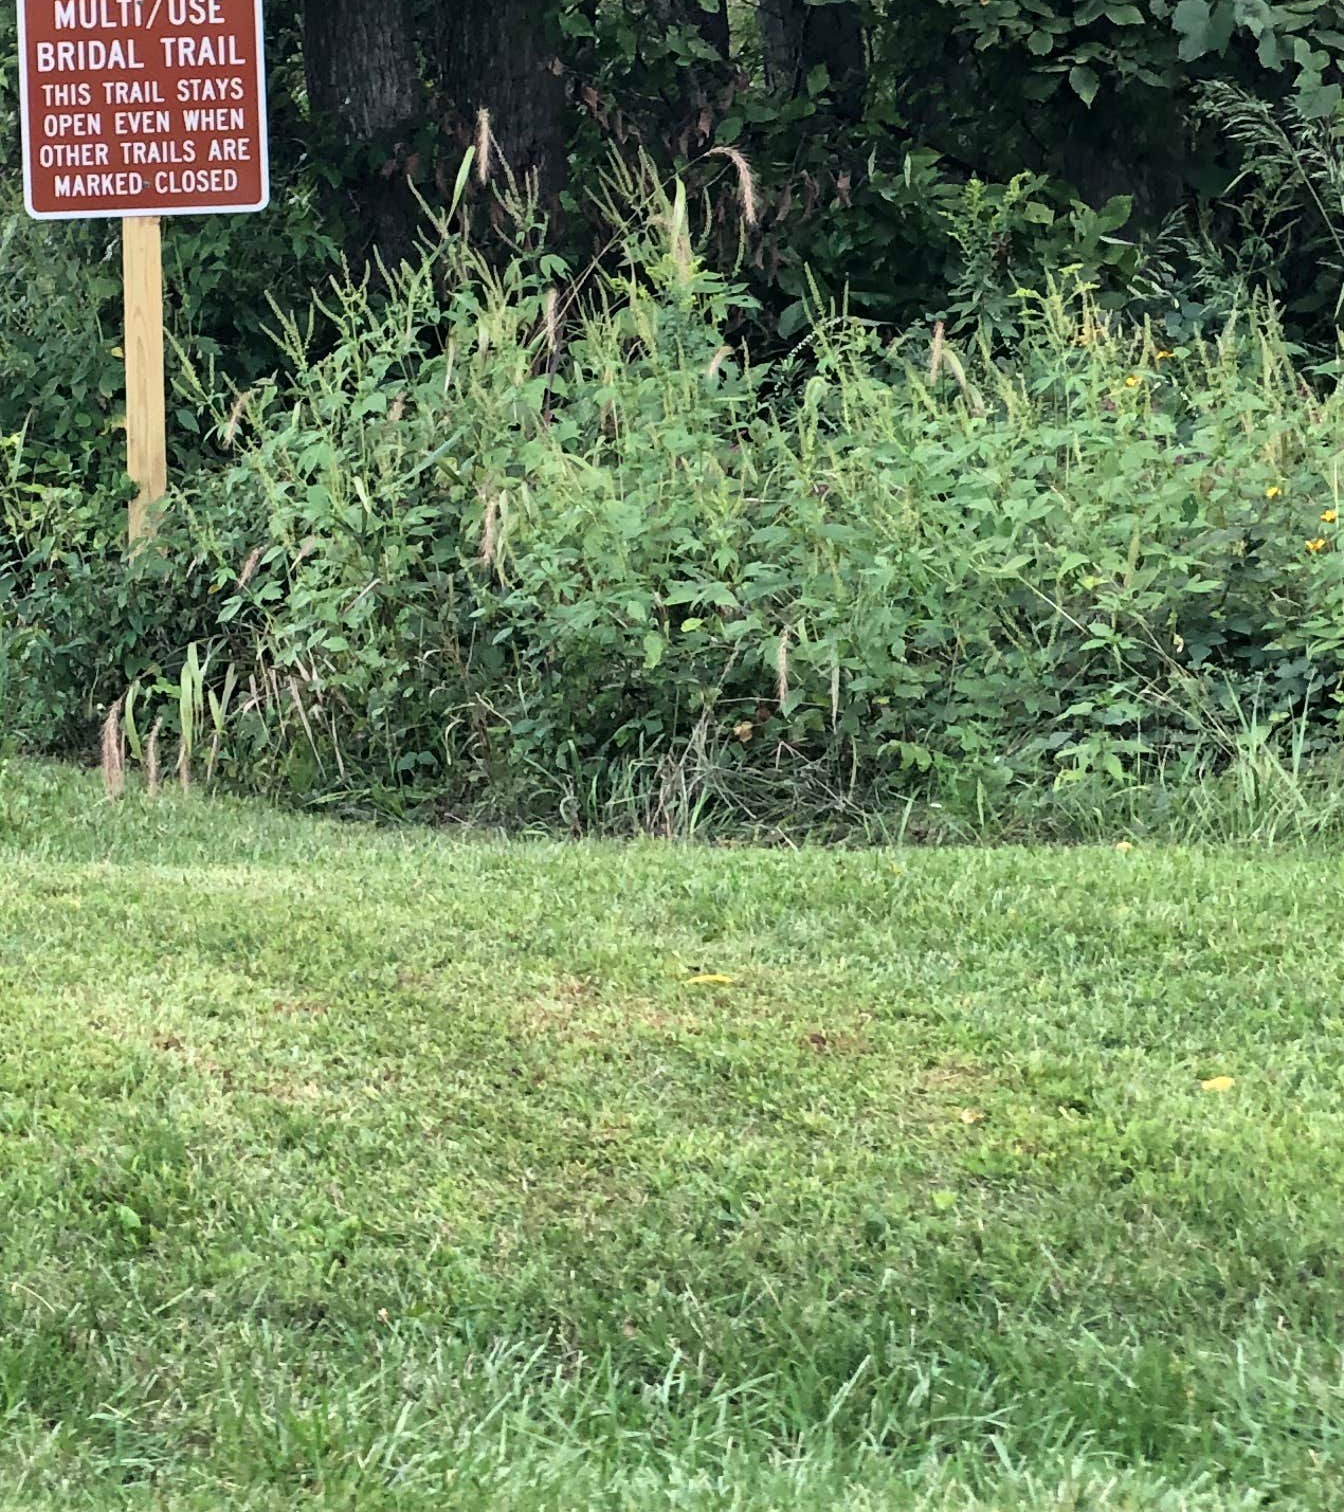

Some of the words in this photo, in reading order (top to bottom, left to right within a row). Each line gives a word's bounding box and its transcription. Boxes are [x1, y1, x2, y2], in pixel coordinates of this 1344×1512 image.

[37, 39, 144, 72] BRIDAL
[160, 36, 246, 67] TRAIL
[41, 83, 90, 106] THIS
[103, 81, 165, 105] TRAIL
[177, 78, 244, 102] STAYS
[44, 113, 101, 136] OPEN
[115, 111, 170, 134] EVEN
[183, 108, 244, 131] WHEN
[39, 144, 108, 168] OTHER
[120, 140, 195, 164] TRAILS
[208, 138, 251, 161] ARE
[55, 173, 142, 197] MARKED
[155, 169, 237, 195] CLOSED
